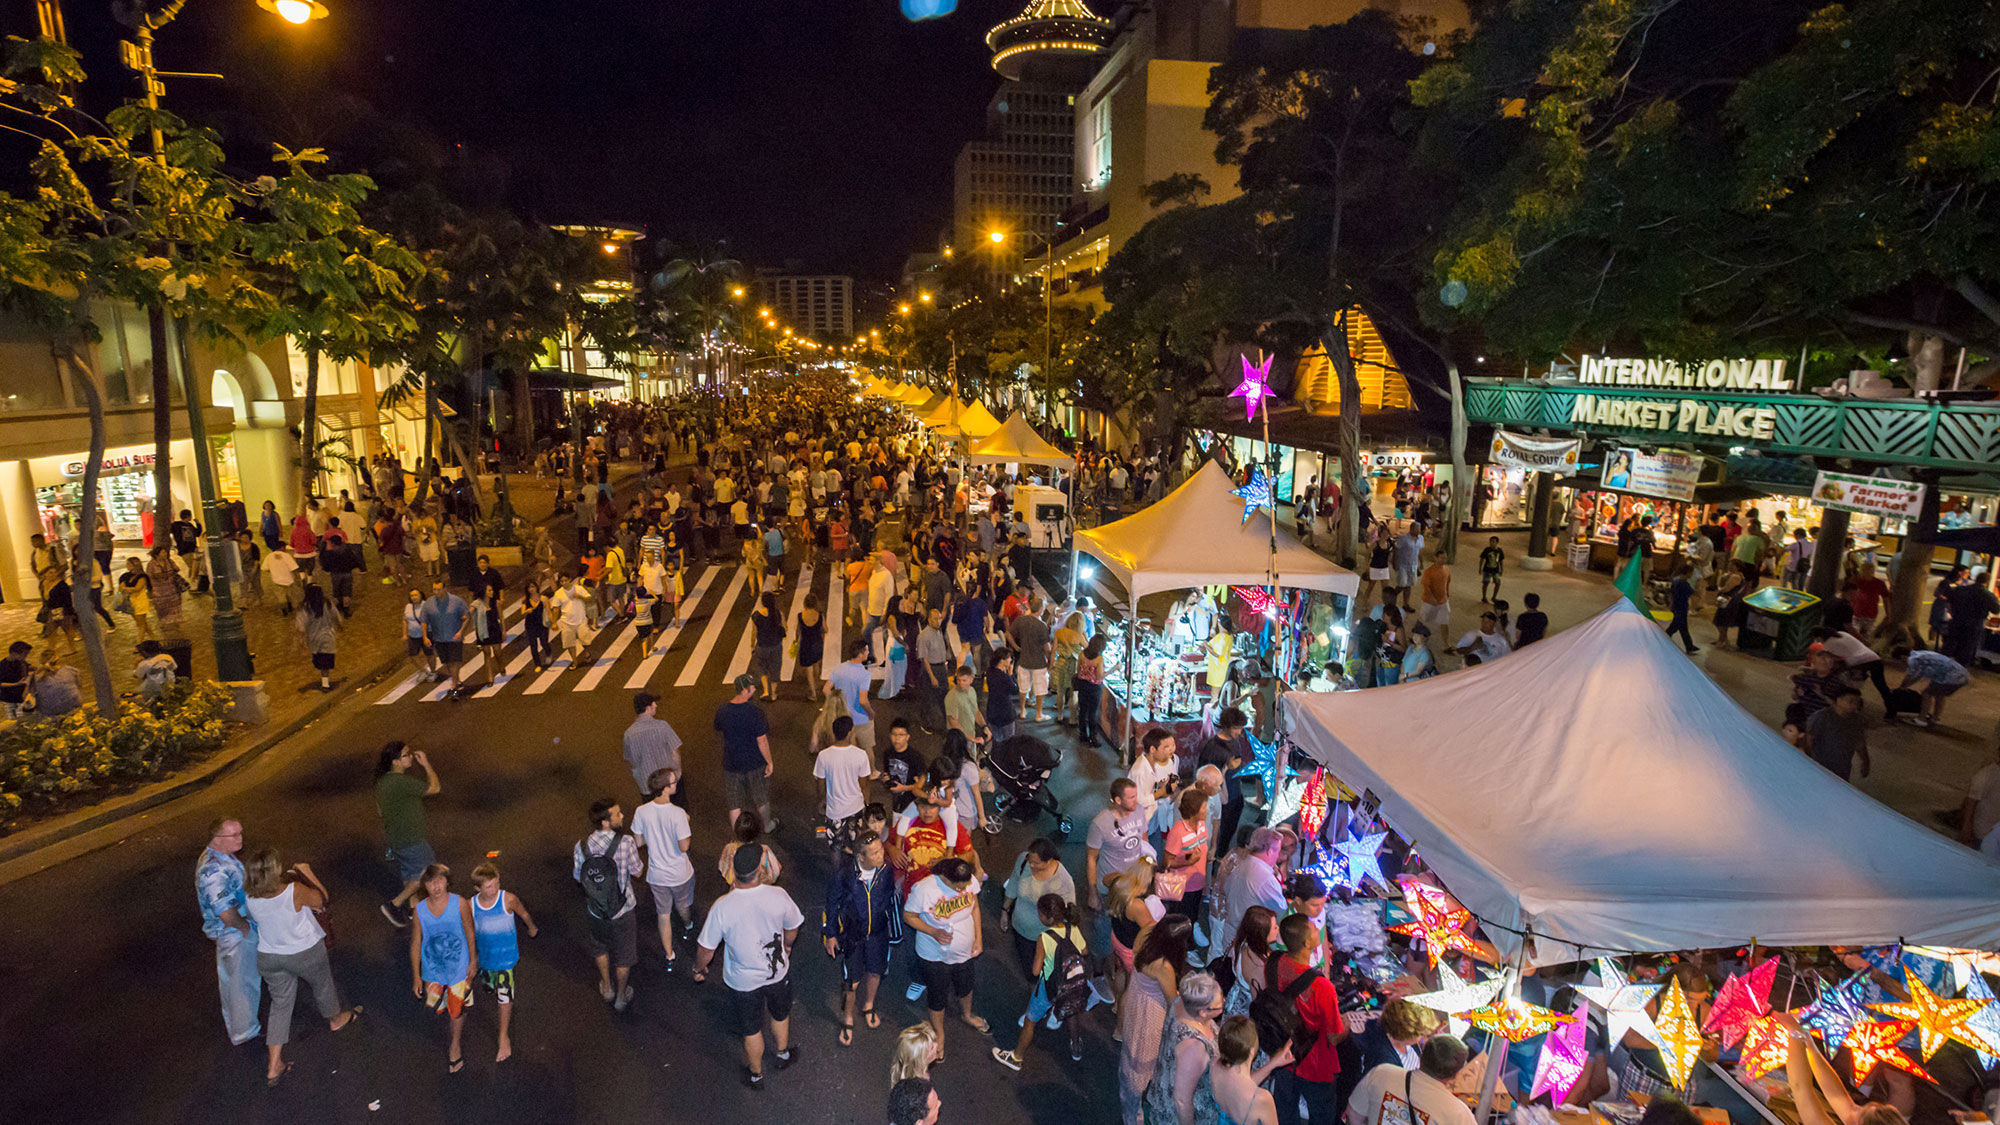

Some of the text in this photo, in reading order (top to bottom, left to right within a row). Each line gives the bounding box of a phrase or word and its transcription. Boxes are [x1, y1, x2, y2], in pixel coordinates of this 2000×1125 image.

[1571, 394, 1776, 440] MARKET PLACE
[1387, 456, 1417, 465] ROXY
[1501, 448, 1530, 462] ROYAL
[1849, 485, 1918, 502] Farmer's
[1852, 495, 1908, 512] Market
